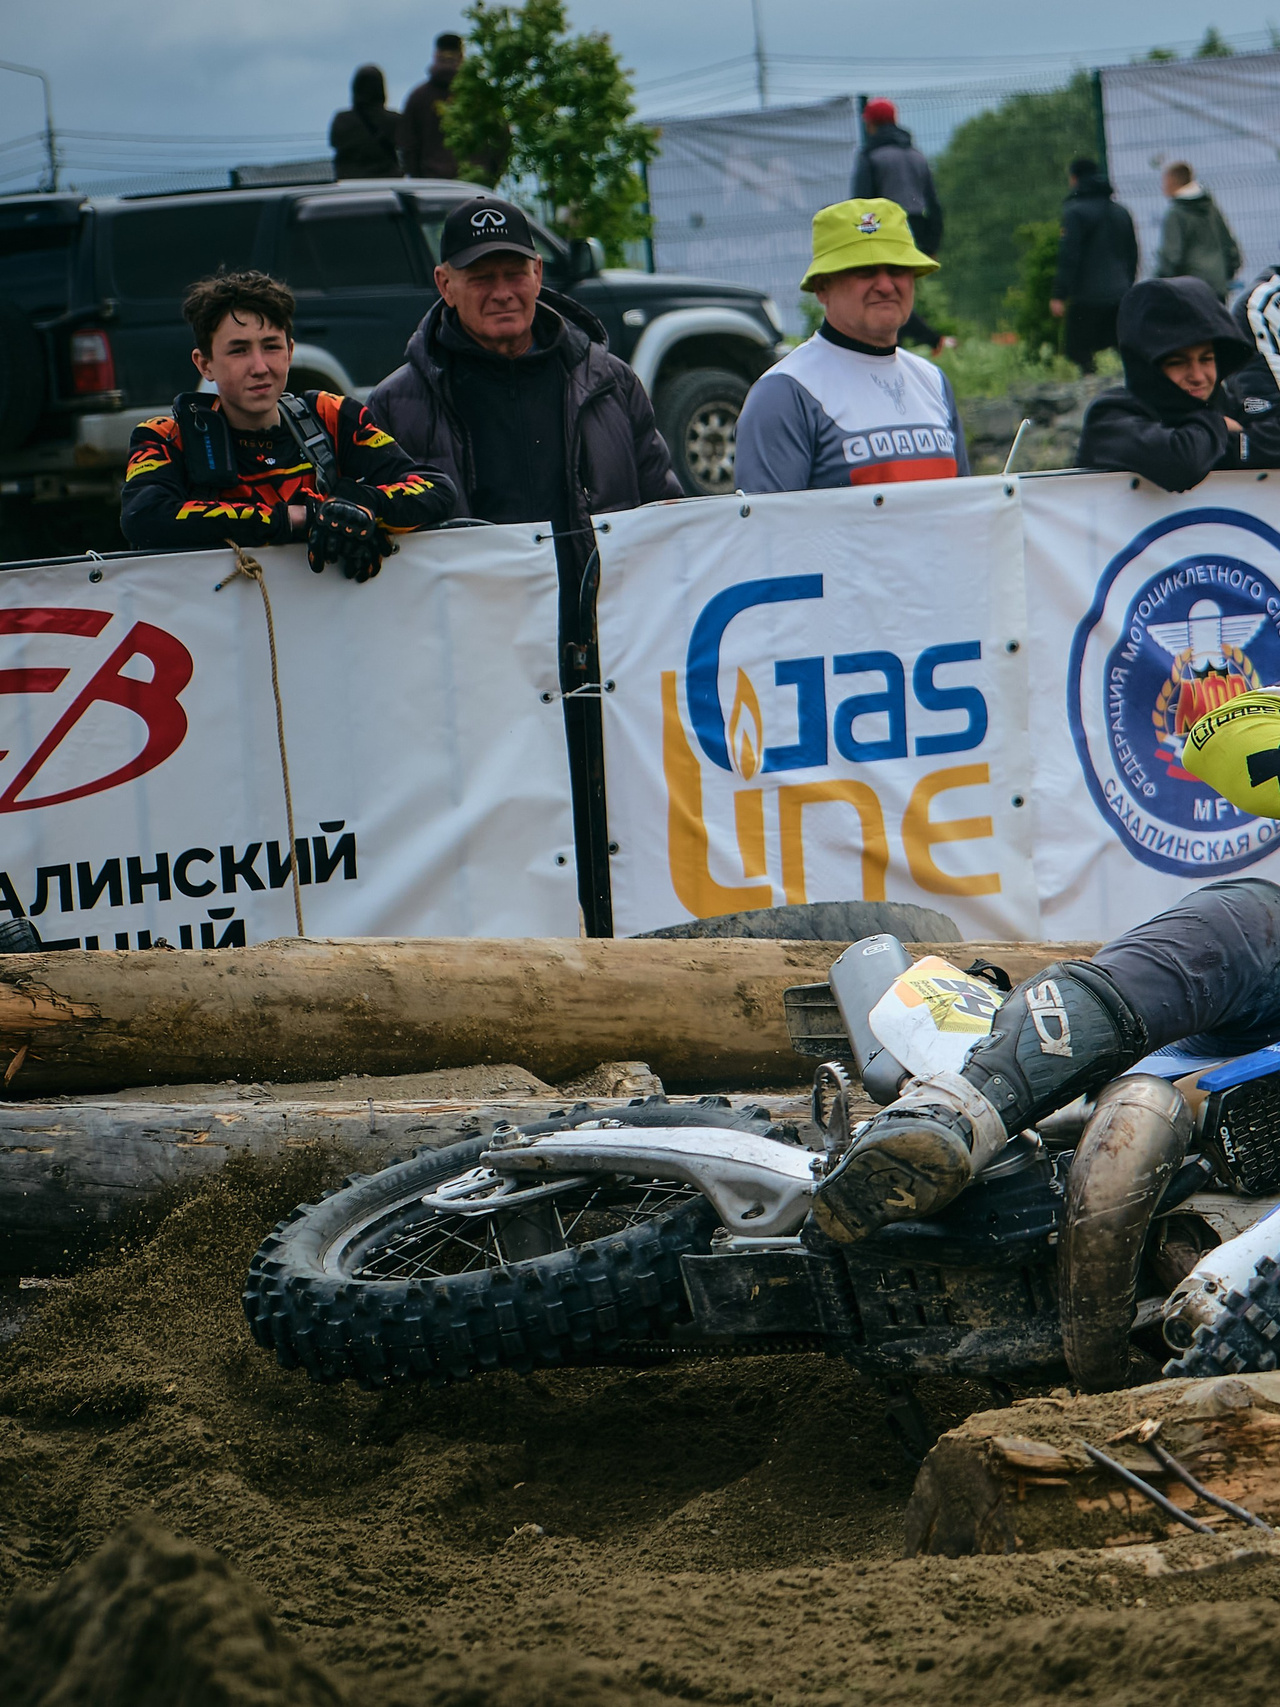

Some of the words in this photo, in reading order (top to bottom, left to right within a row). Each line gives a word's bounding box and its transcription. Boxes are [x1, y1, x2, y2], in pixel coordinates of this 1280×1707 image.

[472, 227, 508, 237] INFINITI
[175, 500, 273, 525] FXR
[1121, 564, 1263, 663] МОТОЦИКЛЕТНОГО
[1109, 667, 1156, 797] ФЕДЕРАЦИЯ
[1103, 778, 1250, 862] САХАЛИНСКАЯ
[1193, 798, 1241, 821] MF
